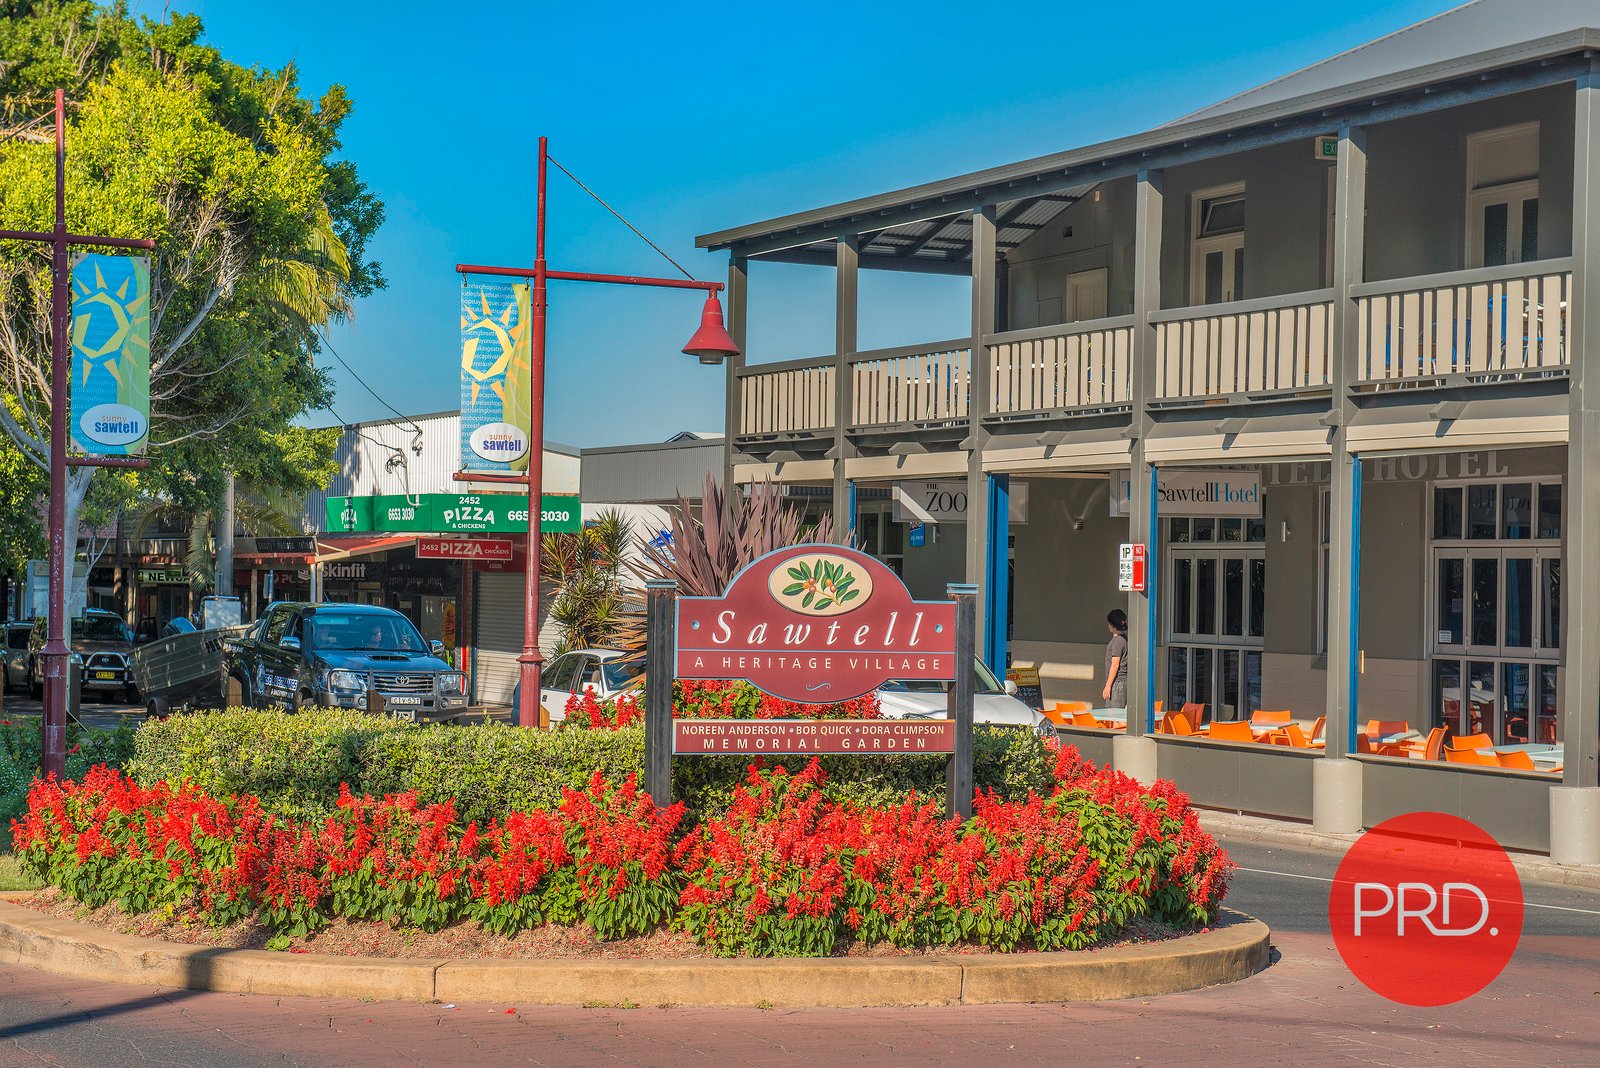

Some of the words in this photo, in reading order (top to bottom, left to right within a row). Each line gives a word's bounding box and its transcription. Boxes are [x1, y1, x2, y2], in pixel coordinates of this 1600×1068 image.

[1325, 143, 1337, 154] EXI
[102, 415, 127, 423] sunny
[94, 421, 138, 433] sawtell
[483, 440, 521, 451] sawtell
[1372, 451, 1509, 481] HOTEL
[926, 491, 967, 512] ZOO
[341, 508, 358, 524] PIZZA
[388, 508, 401, 520] 6653
[402, 508, 415, 520] 3030
[443, 506, 495, 524] PIZZA
[507, 511, 529, 521] 665
[541, 511, 570, 521] 3030
[440, 543, 483, 555] PIZZA
[712, 610, 924, 646] Sawtell
[694, 656, 704, 668] A
[723, 657, 832, 669] HERITAGE
[849, 658, 940, 670] VILLAGE
[682, 725, 725, 735] NOREEN
[729, 725, 786, 735] ANDERSON
[796, 725, 817, 735] BOB
[820, 725, 852, 736] QUICK
[862, 725, 890, 735] DORA
[894, 725, 945, 735] CLIMPSON
[703, 738, 821, 749] MEMORIAL
[842, 738, 926, 749] GARDEN
